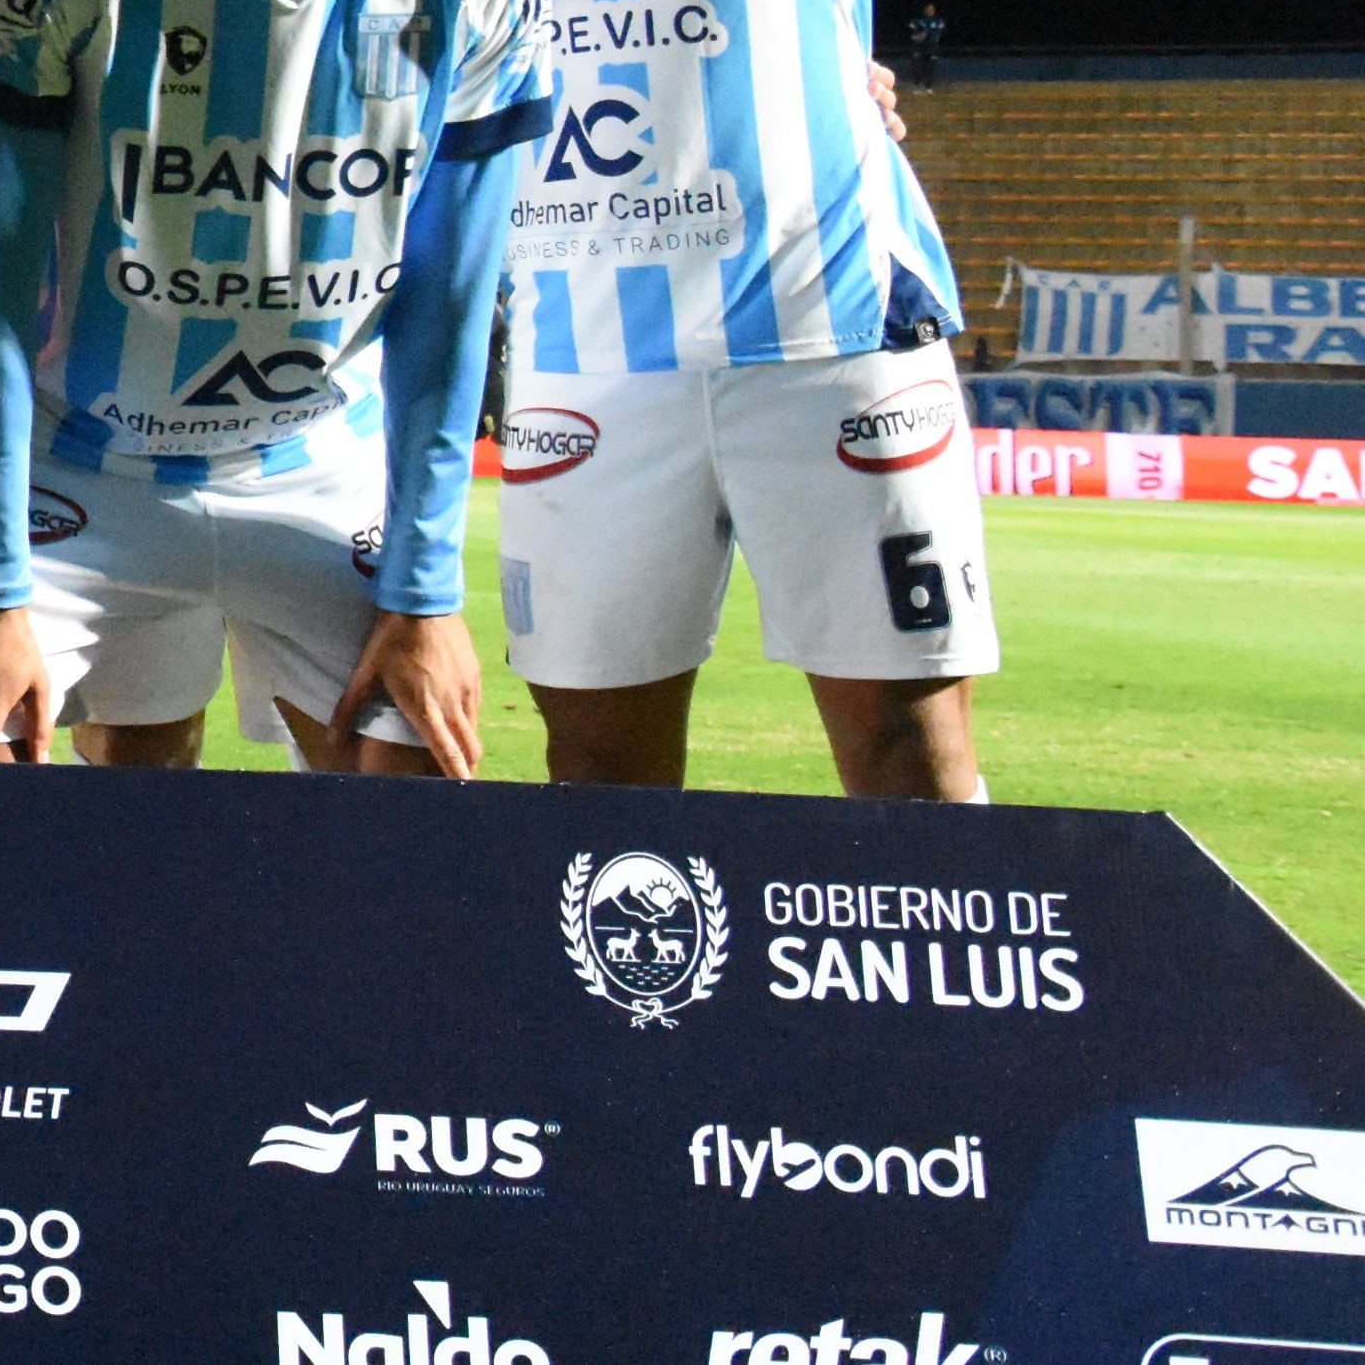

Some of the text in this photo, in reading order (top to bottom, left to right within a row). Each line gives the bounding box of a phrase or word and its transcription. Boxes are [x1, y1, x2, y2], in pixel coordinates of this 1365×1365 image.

[159, 83, 202, 97] LYON
[608, 183, 727, 226] Capital
[612, 227, 730, 255] TRADING
[180, 349, 329, 407] AC
[102, 402, 258, 436] Adhemar
[1136, 449, 1164, 492] 710
[877, 530, 953, 633] 6
[764, 879, 1072, 938] GOBIERNO DE
[767, 935, 1087, 1013] SAN LUIS
[373, 1113, 544, 1179] RUS
[688, 1122, 988, 1200] flybondi
[406, 1181, 475, 1196] URUGUAY
[477, 1183, 547, 1198] SEGUROS
